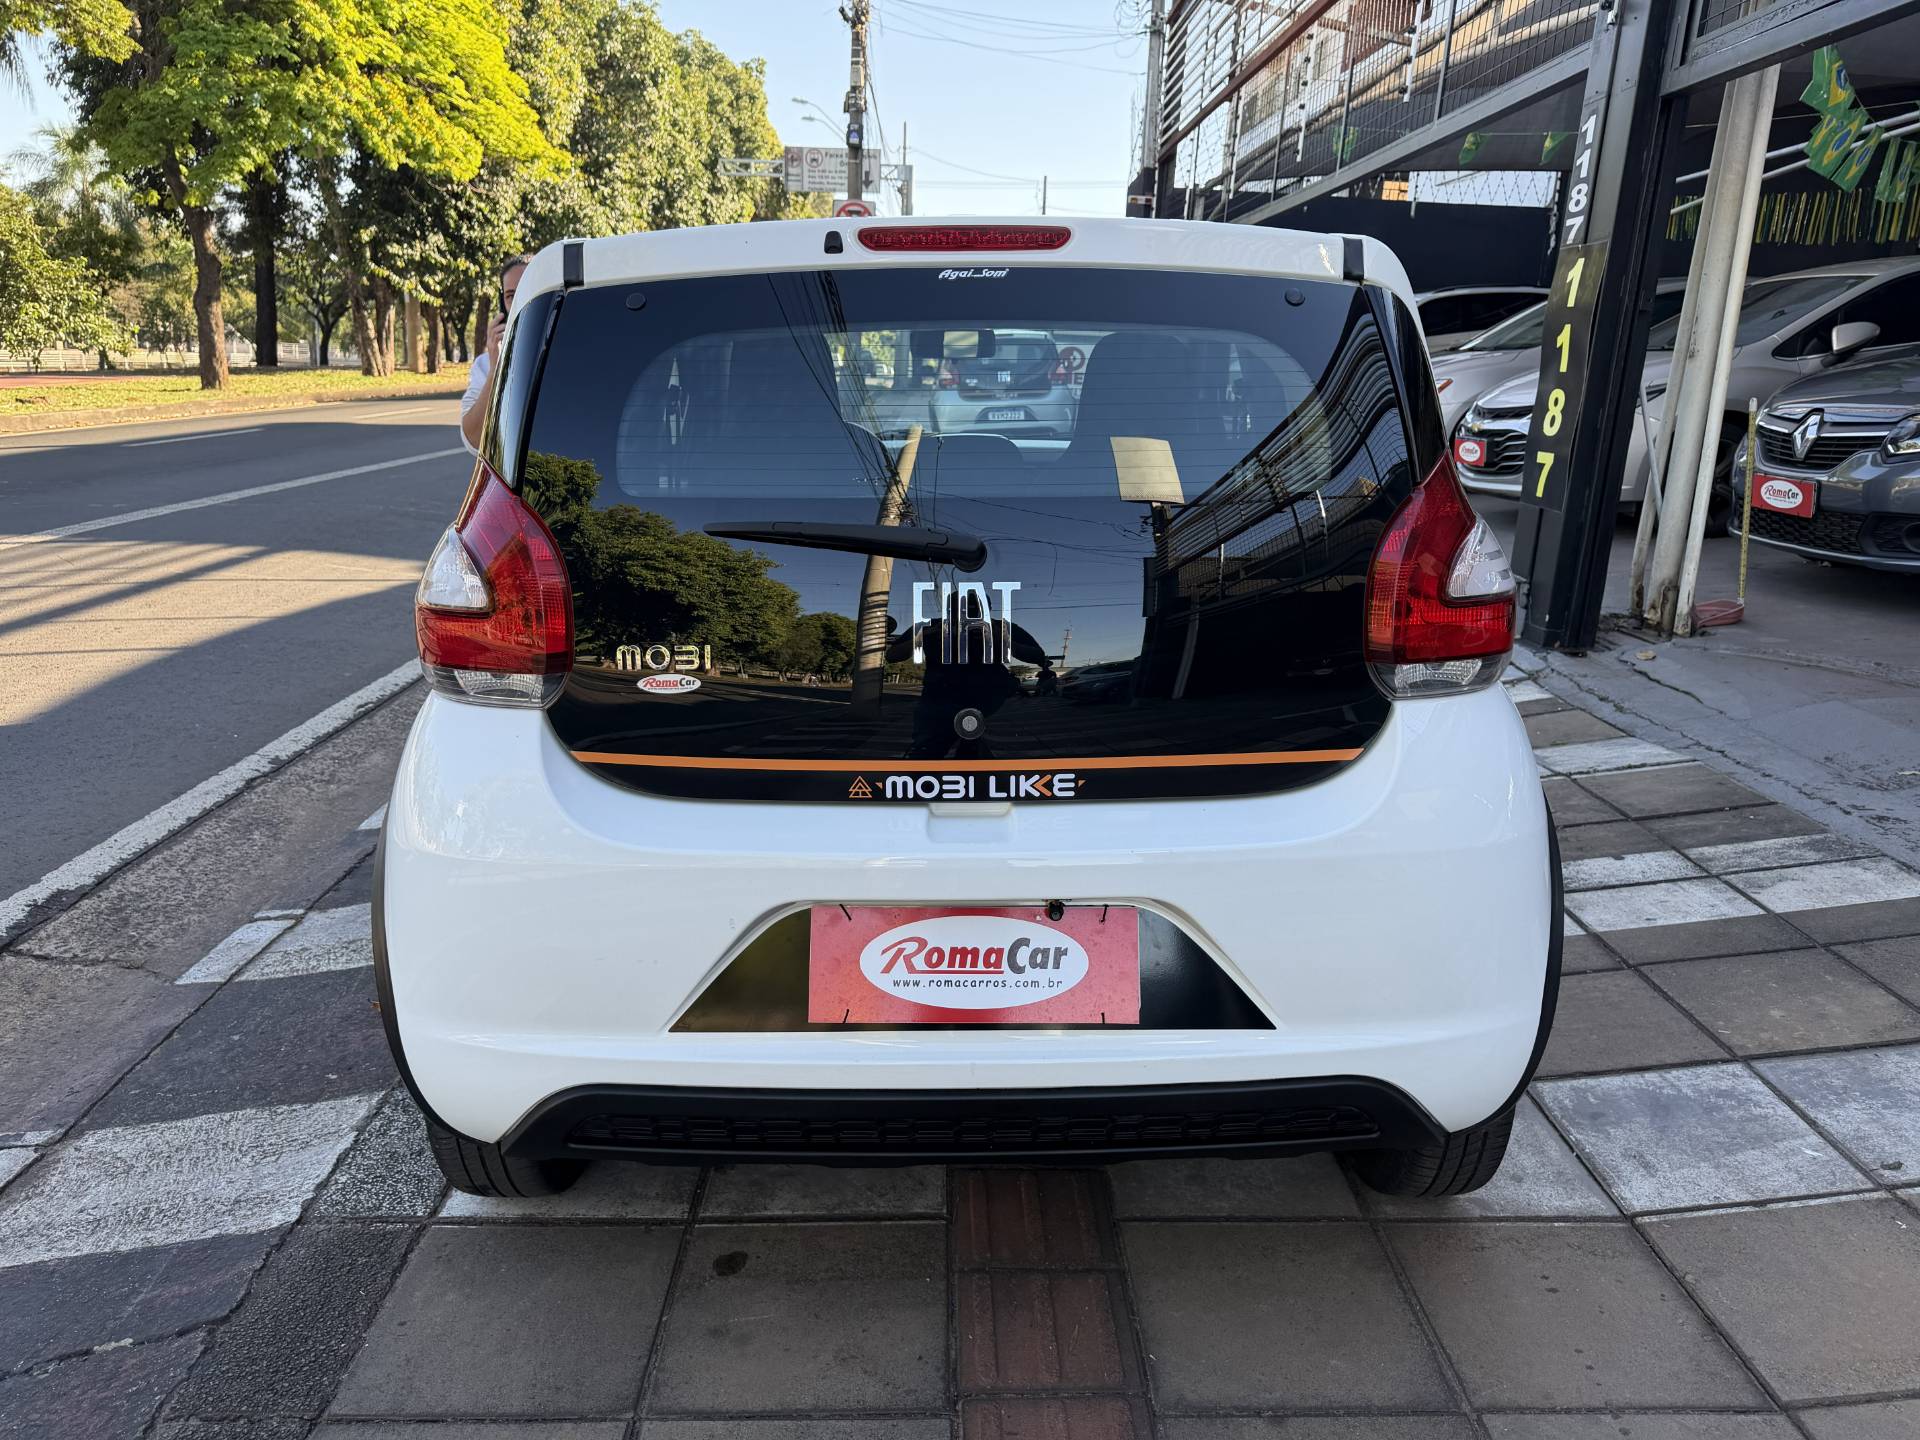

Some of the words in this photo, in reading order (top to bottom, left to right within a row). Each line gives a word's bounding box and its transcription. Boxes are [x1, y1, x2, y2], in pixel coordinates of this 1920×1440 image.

[1565, 113, 1598, 245] 1187
[1535, 257, 1586, 499] 1187
[1764, 484, 1799, 500] RomaCar
[912, 581, 1022, 664] FIAT
[616, 644, 712, 671] MOBI
[643, 677, 697, 688] RomaCar
[885, 775, 975, 799] MOBI
[880, 936, 1068, 975] RomaCar
[892, 977, 1064, 989] www.romacarros.com.br
